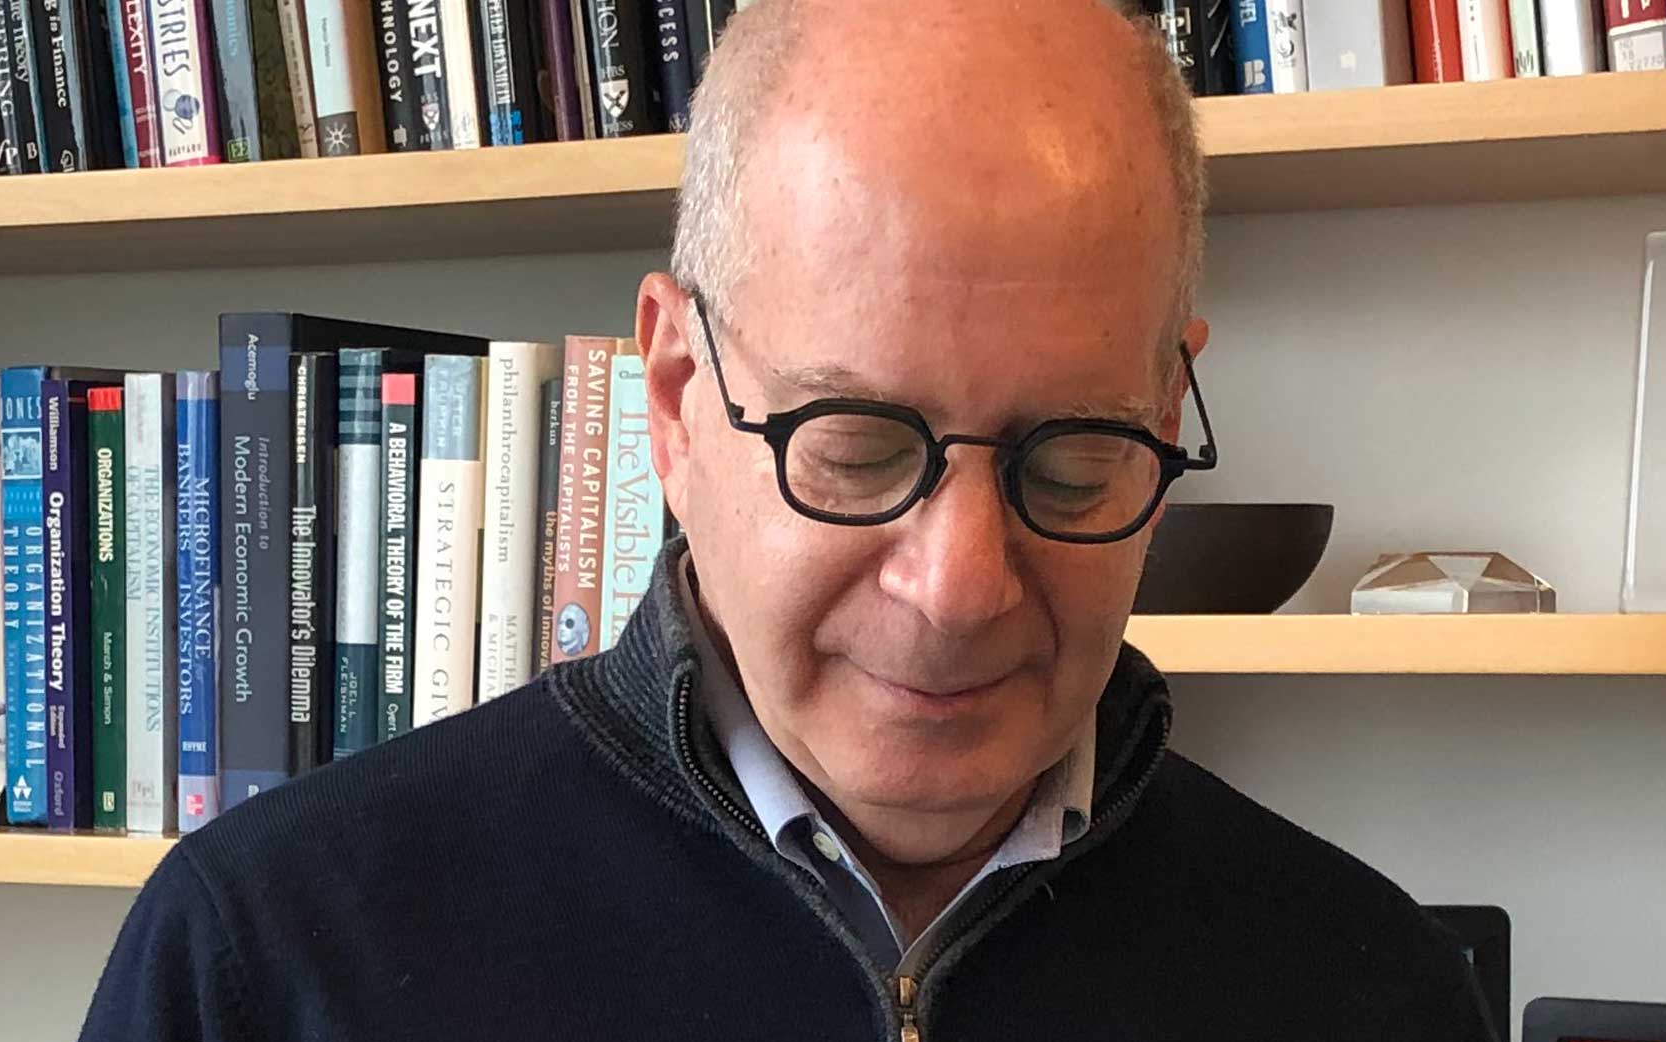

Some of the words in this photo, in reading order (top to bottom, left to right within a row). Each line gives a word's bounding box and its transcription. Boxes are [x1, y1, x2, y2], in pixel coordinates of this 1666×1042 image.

[14, 26, 30, 82] Theory
[51, 35, 68, 108] Finance
[244, 334, 259, 400] Acemoglu
[565, 365, 579, 414] FROM
[585, 349, 607, 435] SAVING
[48, 396, 60, 471] Williamson
[296, 366, 306, 463] CHRISTENSEN
[389, 423, 406, 434] A
[563, 422, 576, 455] THE
[617, 401, 650, 470] The
[126, 465, 141, 492] OF
[144, 465, 160, 503] THE
[177, 442, 192, 551] BANKERS
[234, 436, 252, 515] Modern
[258, 436, 271, 531] Introduction
[387, 438, 406, 532] BEHAVIORAL
[496, 357, 519, 563] philanthrocapitalism
[98, 448, 113, 562] ORGANIZATIONS
[258, 535, 271, 549] to
[292, 505, 317, 537] The
[545, 511, 557, 537] the
[559, 463, 575, 572] CAPITALISTS
[577, 448, 602, 589] CAPITALISM
[613, 471, 650, 587] Visible
[4, 527, 20, 629] THEORY
[47, 492, 66, 616] Organization
[127, 496, 142, 601] CAPITALISM
[144, 511, 160, 599] ECONOMIC
[194, 477, 211, 659] MICROFINANCE
[234, 522, 253, 622] Economic
[386, 536, 404, 596] THEORY
[434, 481, 456, 651] STRATEGIC
[541, 541, 555, 590] myths
[290, 542, 316, 640] Innovator's
[386, 599, 403, 621] OF
[542, 595, 554, 611] of
[24, 527, 46, 768] ORGANIZATIONAL
[47, 622, 67, 691] Theory
[145, 607, 161, 732] INSTITUTIONS
[178, 583, 193, 714] INVESTORS
[234, 627, 253, 703] Growth
[385, 652, 402, 694] FIRM
[386, 624, 403, 649] THE
[103, 686, 113, 724] Simon
[104, 673, 113, 683] &
[290, 645, 316, 722] Dilemma
[340, 656, 348, 733] FLEISHMAN
[349, 672, 357, 706] JOEL
[387, 703, 399, 732] Cyert
[53, 771, 64, 815] Oxford
